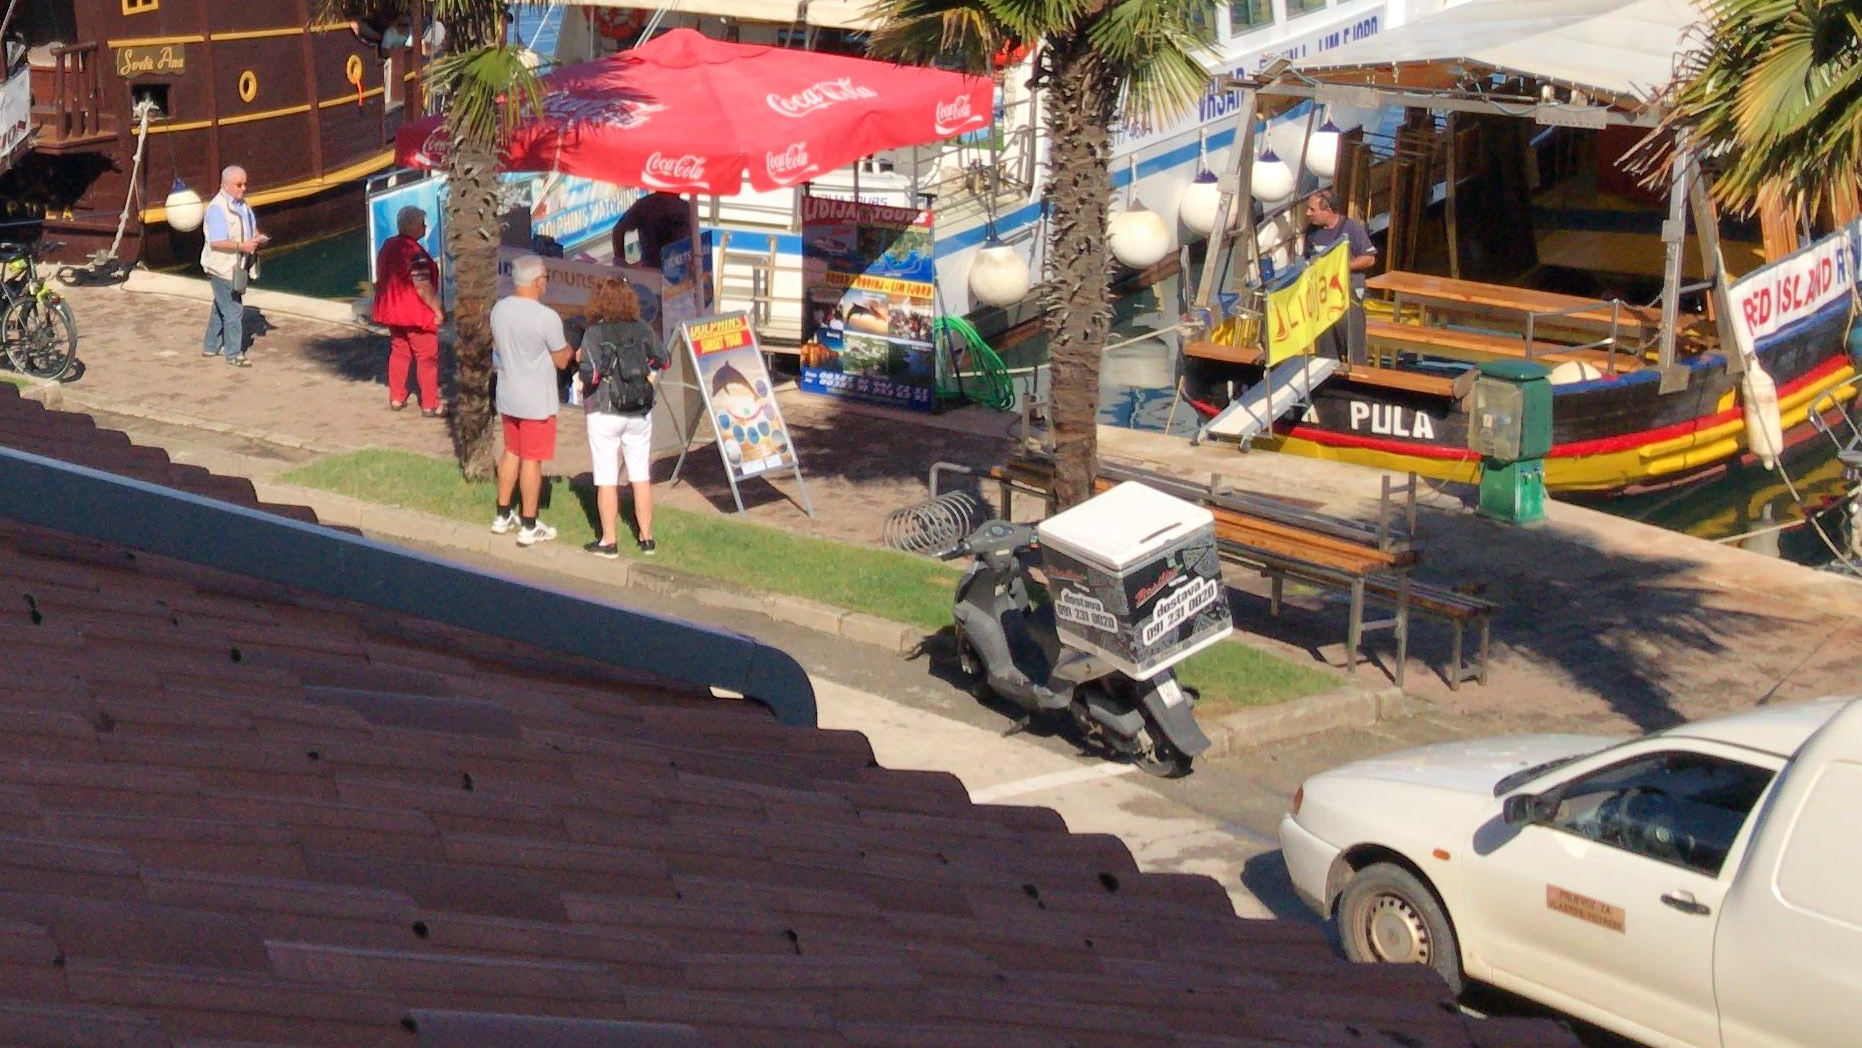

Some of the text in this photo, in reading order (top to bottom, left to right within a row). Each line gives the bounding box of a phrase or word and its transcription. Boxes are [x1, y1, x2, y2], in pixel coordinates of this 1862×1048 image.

[156, 46, 184, 70] Ana
[804, 197, 857, 222] LIDIJA
[873, 206, 929, 225] TOURS
[1776, 258, 1832, 316] ISLAND
[1350, 400, 1435, 440] PULA
[1146, 586, 1215, 642] 091 231 0020
[1156, 581, 1201, 619] dostava
